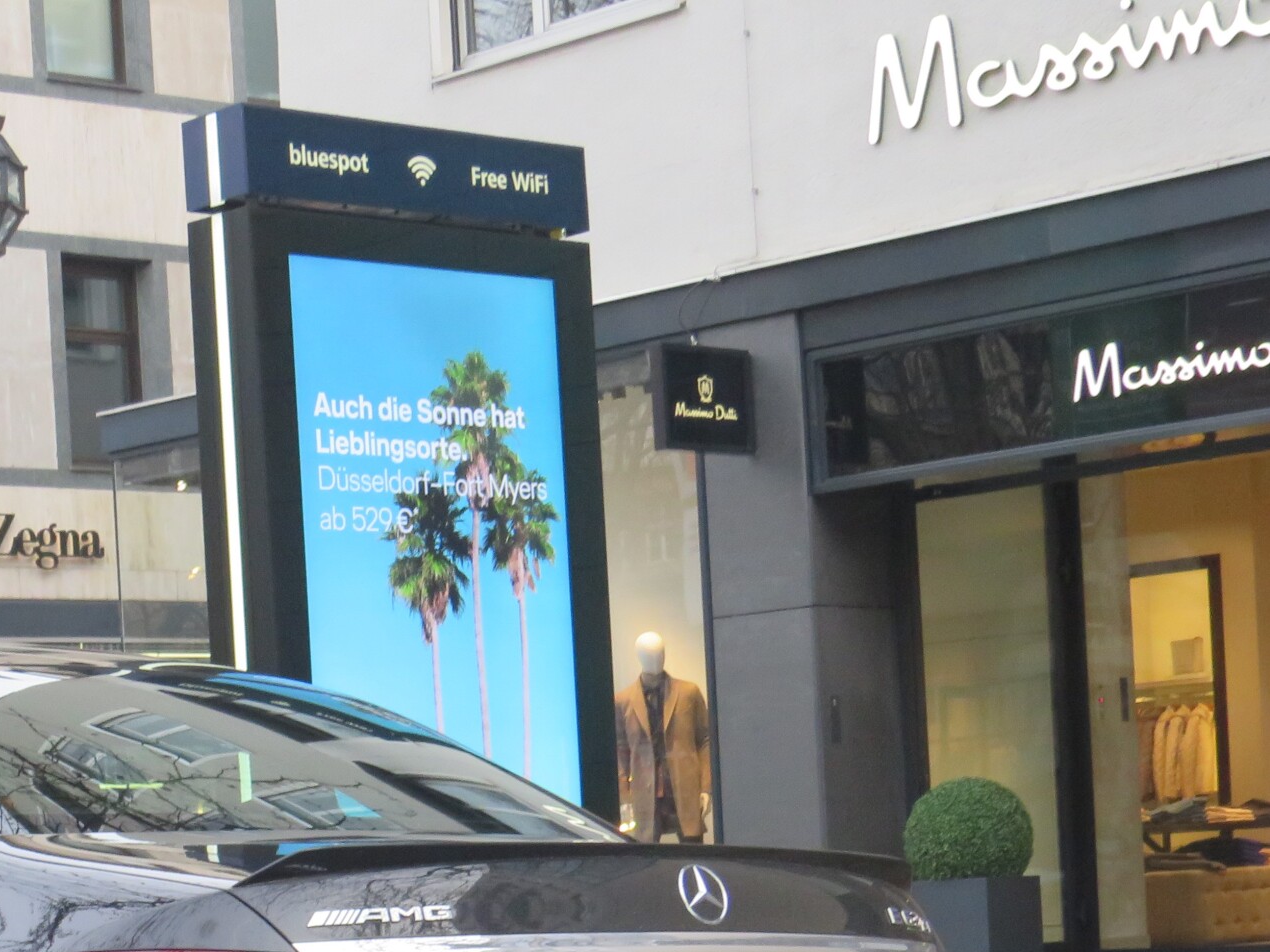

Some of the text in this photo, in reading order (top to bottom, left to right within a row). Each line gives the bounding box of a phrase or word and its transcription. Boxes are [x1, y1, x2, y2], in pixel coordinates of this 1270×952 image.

[288, 142, 549, 195] bluespot Free WiFi
[1073, 341, 1270, 404] Massimo
[314, 391, 526, 430] Auch die Sonne hat
[674, 401, 739, 421] Massimo Dutti
[315, 428, 469, 464] Lieblingsorte.
[488, 474, 548, 505] Myers
[320, 510, 346, 531] ab
[351, 506, 394, 532] 529
[355, 904, 455, 925] AMG
